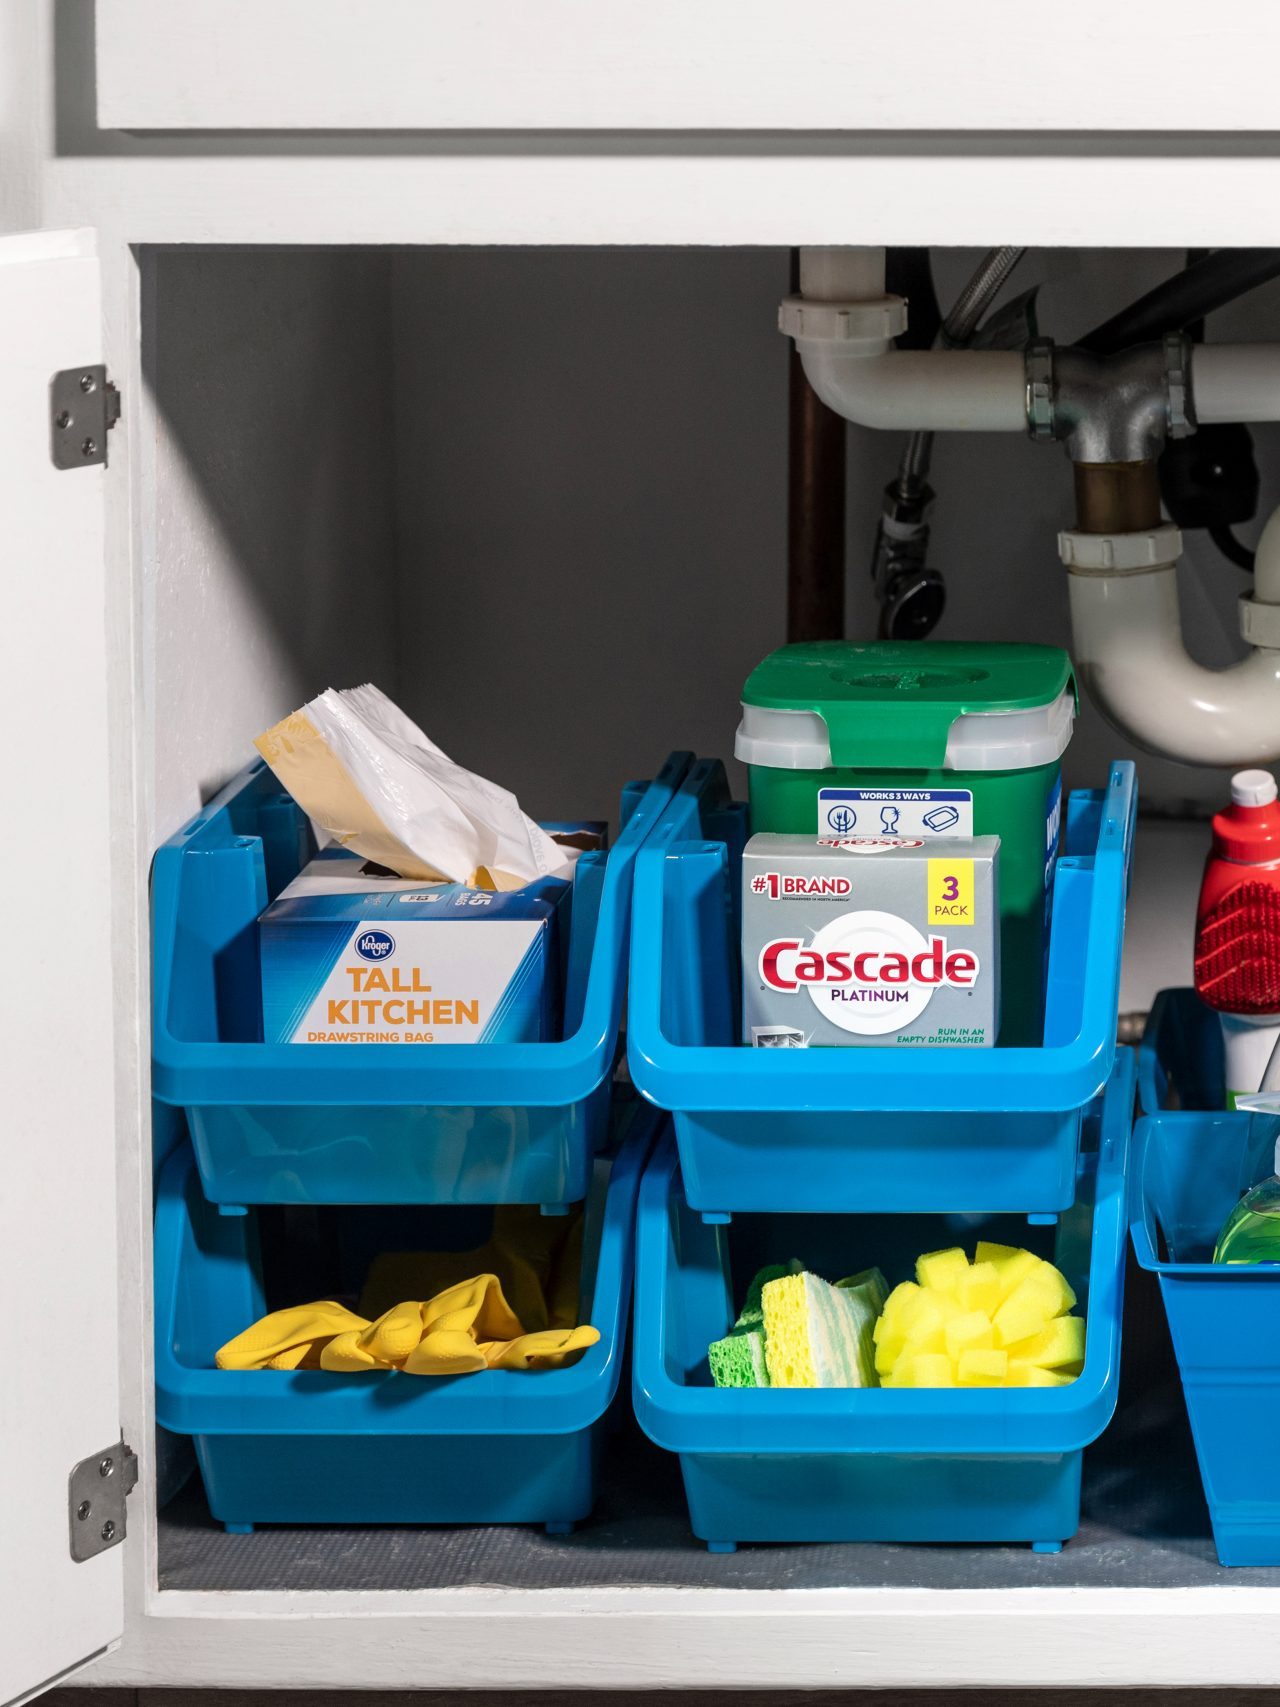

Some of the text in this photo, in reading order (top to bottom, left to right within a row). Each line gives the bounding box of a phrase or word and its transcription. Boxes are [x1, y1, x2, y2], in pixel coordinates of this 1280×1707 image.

[860, 792, 931, 801] WORKS 3 WAYS
[784, 877, 851, 895] BRAND
[942, 875, 959, 902] 3
[934, 905, 969, 916] PACK
[361, 935, 390, 957] Kroger
[762, 937, 976, 990] Cascade
[346, 967, 432, 993] TALL
[831, 989, 909, 1002] PLATINUM
[327, 999, 479, 1025] KITCHEN
[307, 1032, 434, 1043] DRAWSTRING BAG
[937, 1028, 985, 1036] RUN IN AN
[897, 1036, 985, 1044] EMPTY DISHWASHER
